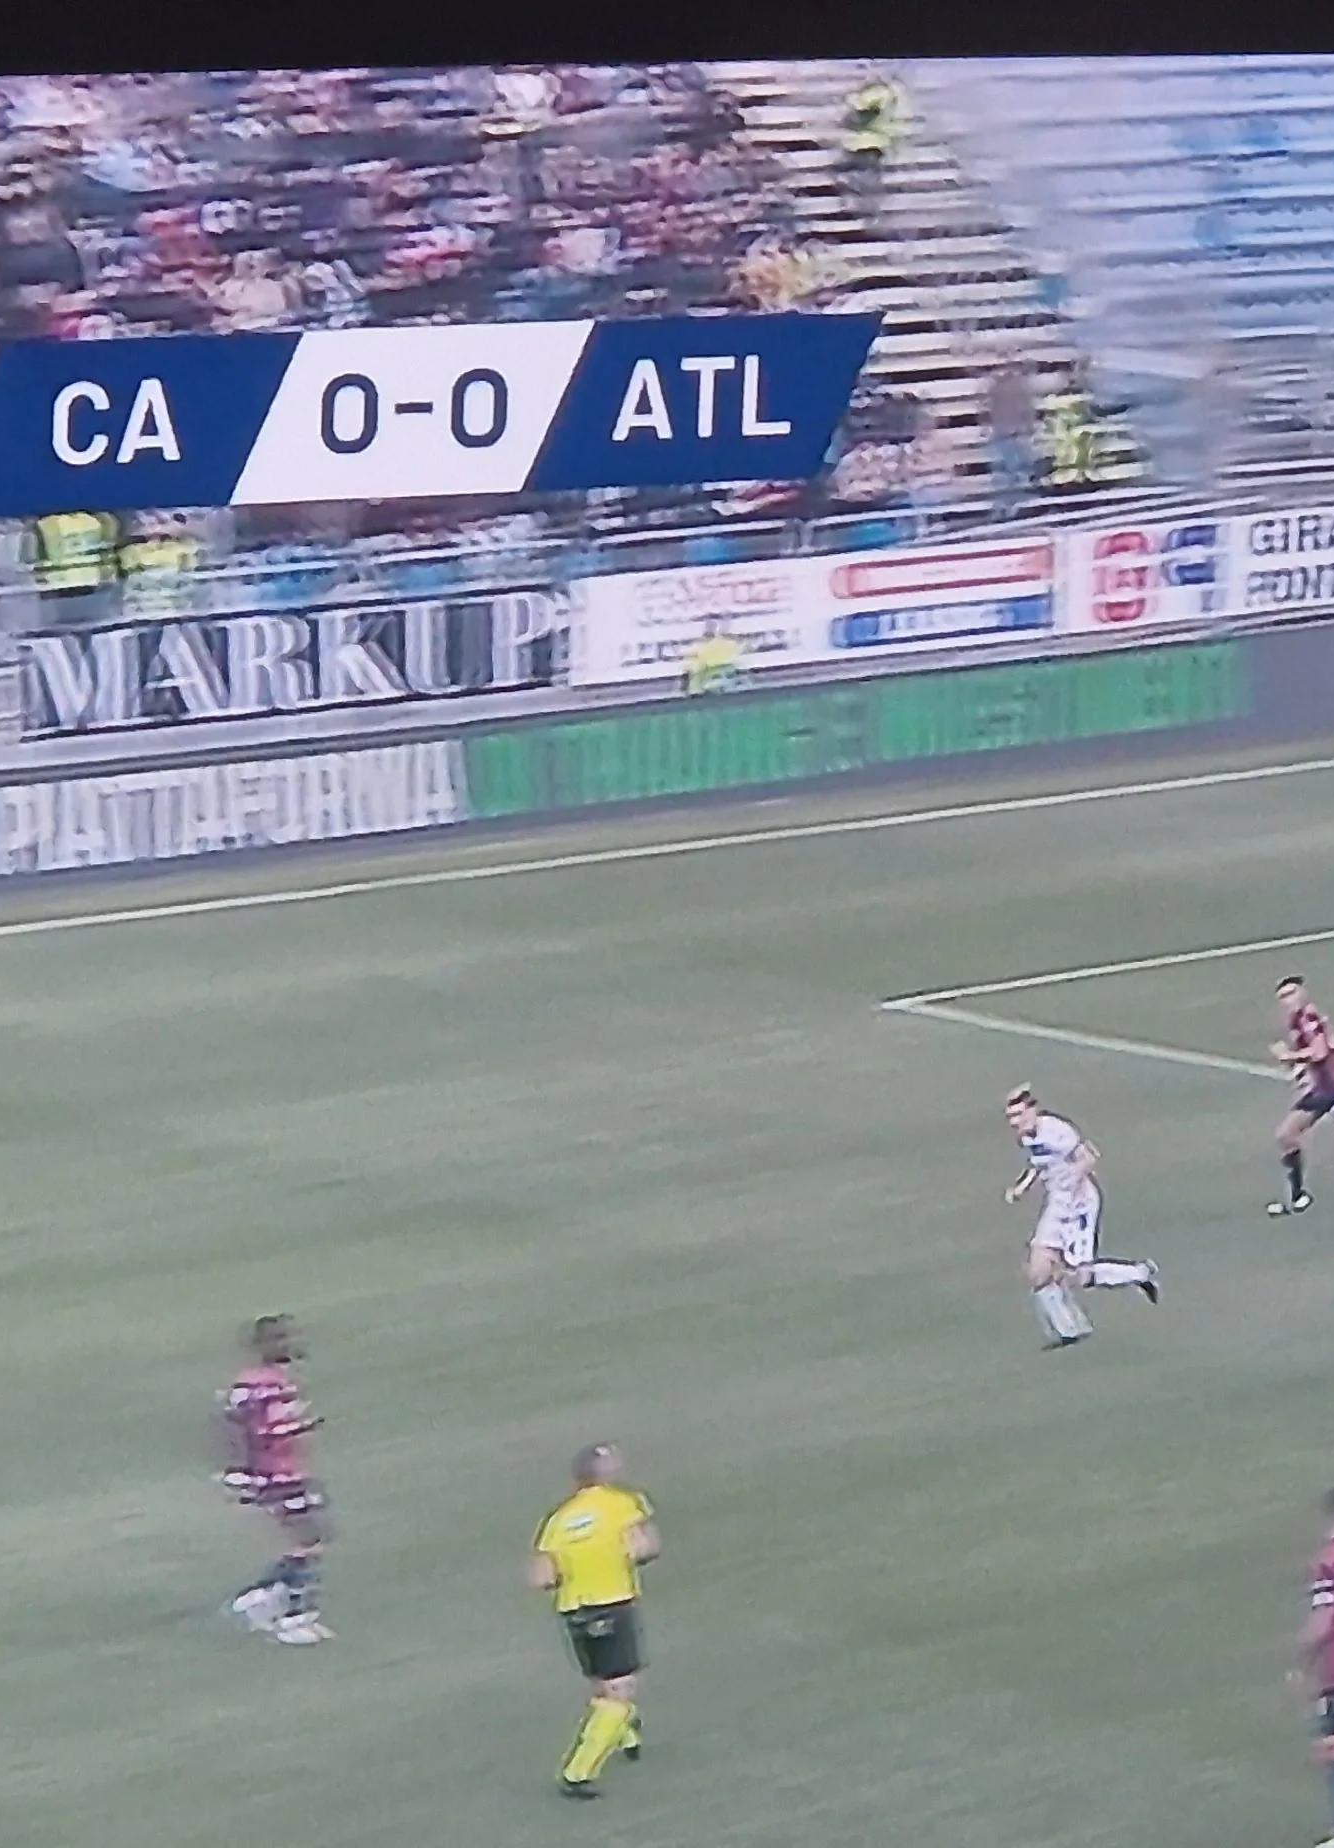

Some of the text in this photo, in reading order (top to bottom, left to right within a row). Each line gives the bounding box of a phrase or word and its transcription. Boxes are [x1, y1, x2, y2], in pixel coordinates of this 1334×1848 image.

[50, 376, 182, 467] CA
[320, 367, 509, 455] 0-0
[611, 353, 792, 442] ATL
[21, 590, 555, 733] MARKUP
